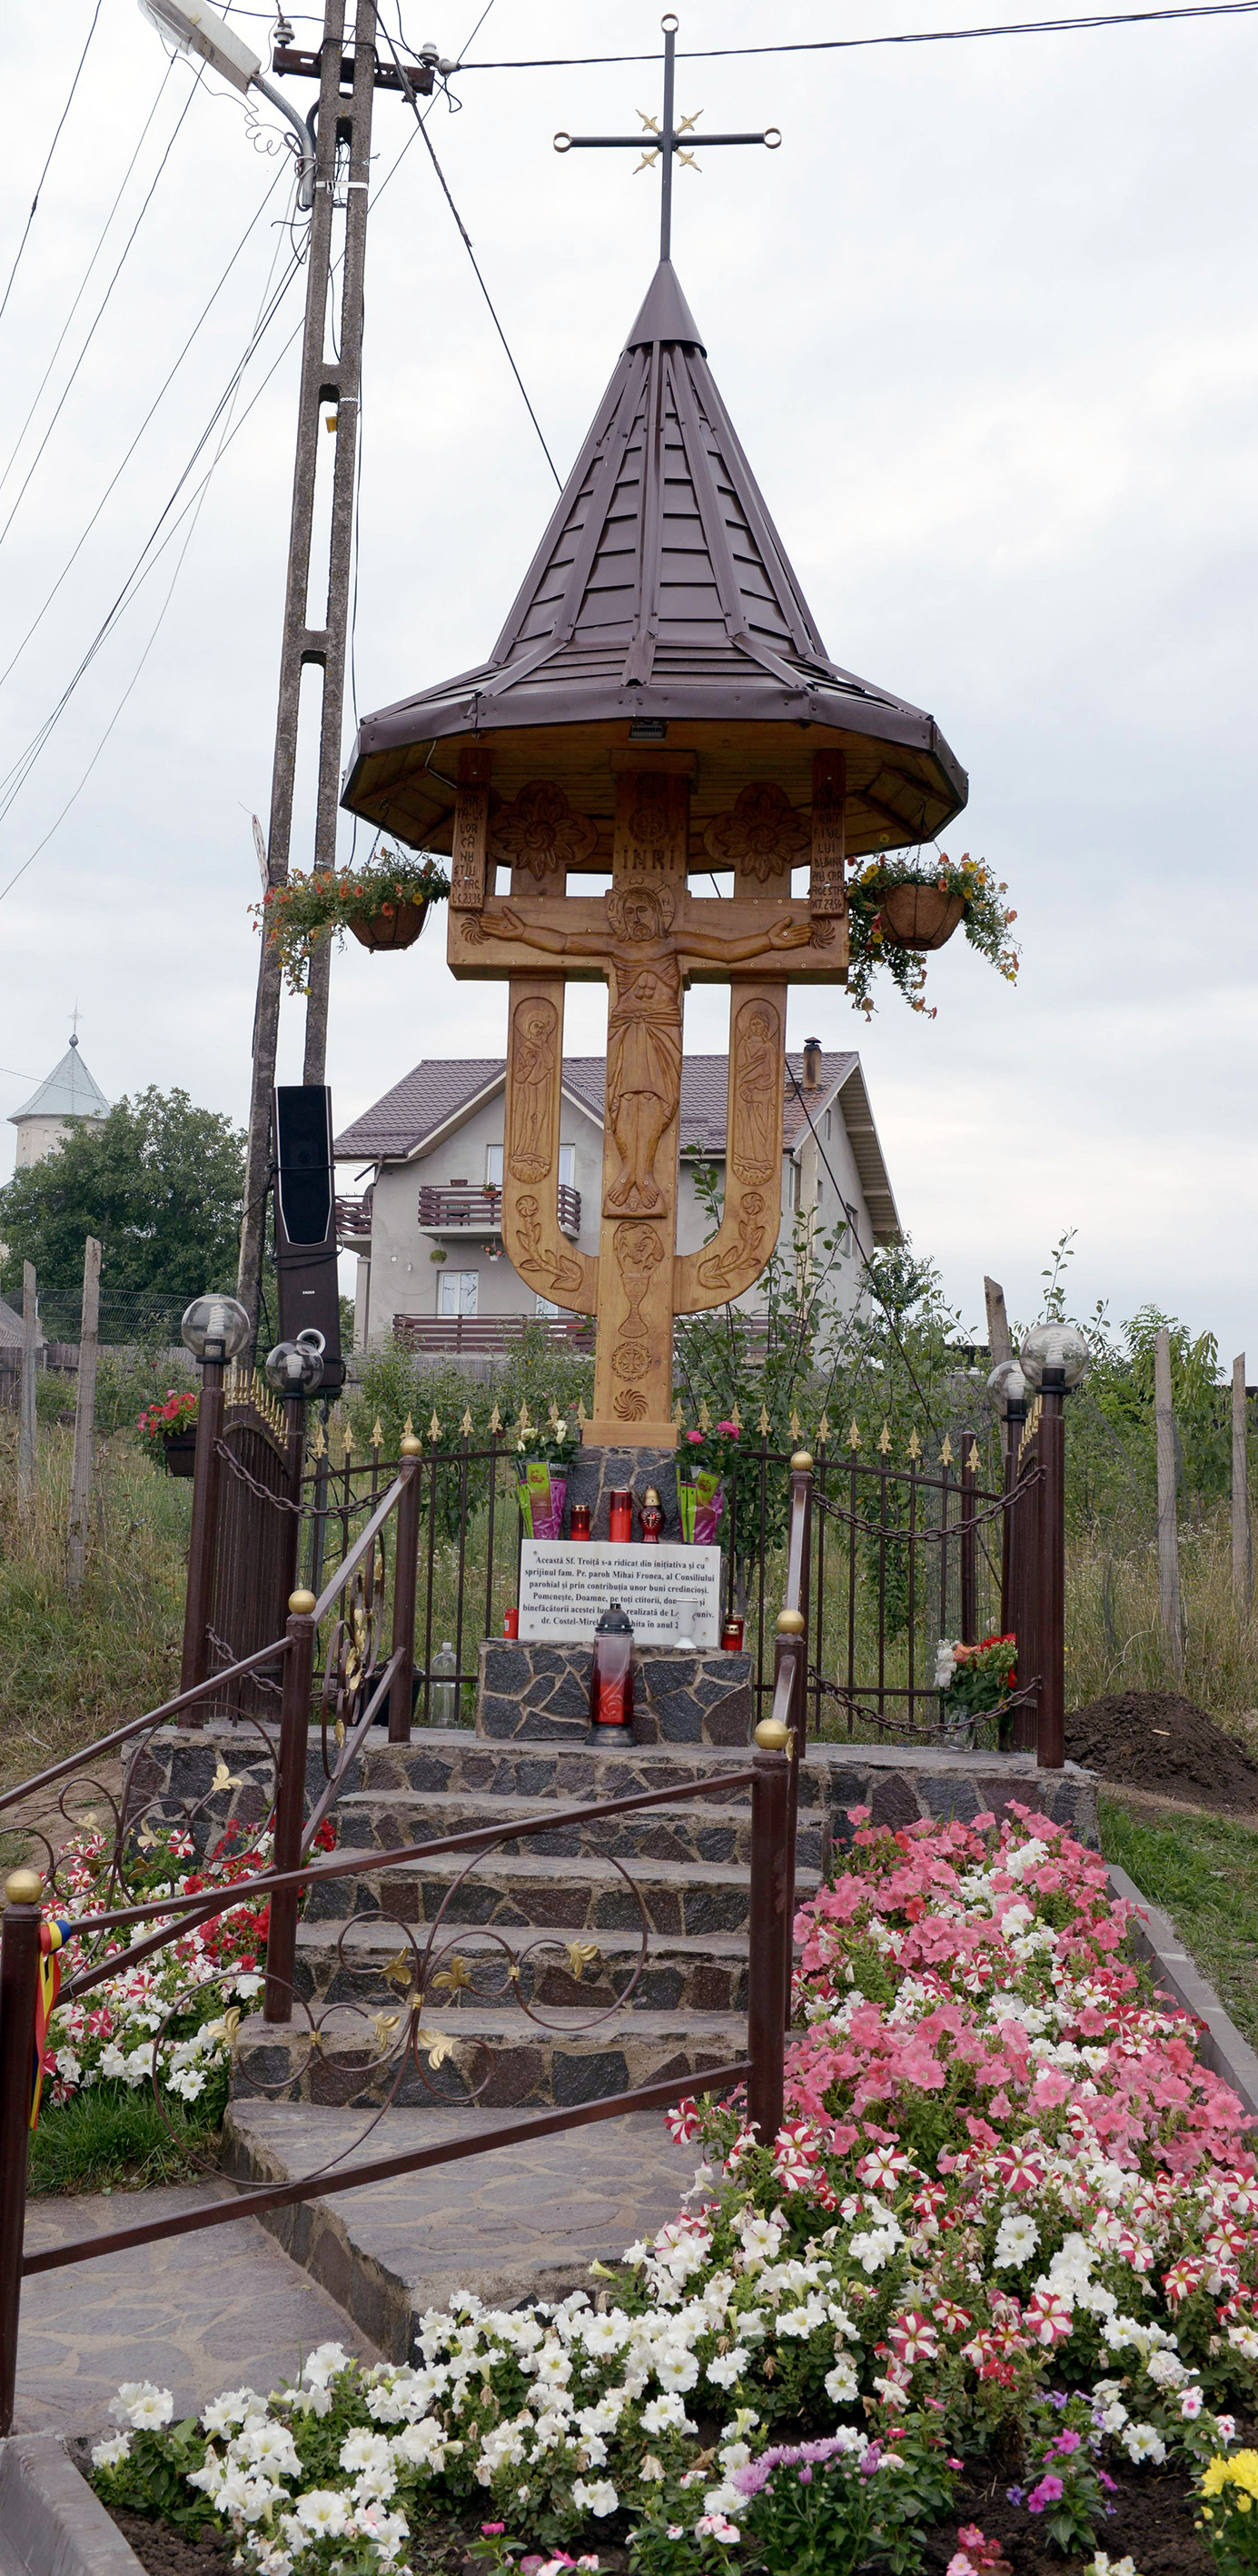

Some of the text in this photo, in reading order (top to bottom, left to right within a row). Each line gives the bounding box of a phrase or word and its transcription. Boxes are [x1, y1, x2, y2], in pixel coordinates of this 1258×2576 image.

[461, 823, 478, 833] LOR
[818, 843, 835, 854] LUI
[623, 845, 675, 870] INRI
[536, 1557, 563, 1565] Această
[614, 1558, 639, 1566] ridicat
[525, 1568, 556, 1578] sprijinul
[559, 1569, 575, 1577] fam.
[577, 1569, 587, 1577] Pr.
[589, 1570, 610, 1580] paroh
[612, 1571, 634, 1579] Mihai
[637, 1572, 665, 1581] Fronea,
[675, 1573, 715, 1582] Consiliului
[529, 1580, 560, 1590] parohial
[570, 1582, 585, 1591] prin
[649, 1584, 666, 1593] buni
[576, 1594, 609, 1603] Doamne,
[635, 1596, 662, 1606] ctitorii,
[522, 1604, 570, 1613] binefăcătorii
[626, 1607, 658, 1616] realizată
[659, 1608, 669, 1616] de
[541, 1616, 551, 1625] dr.
